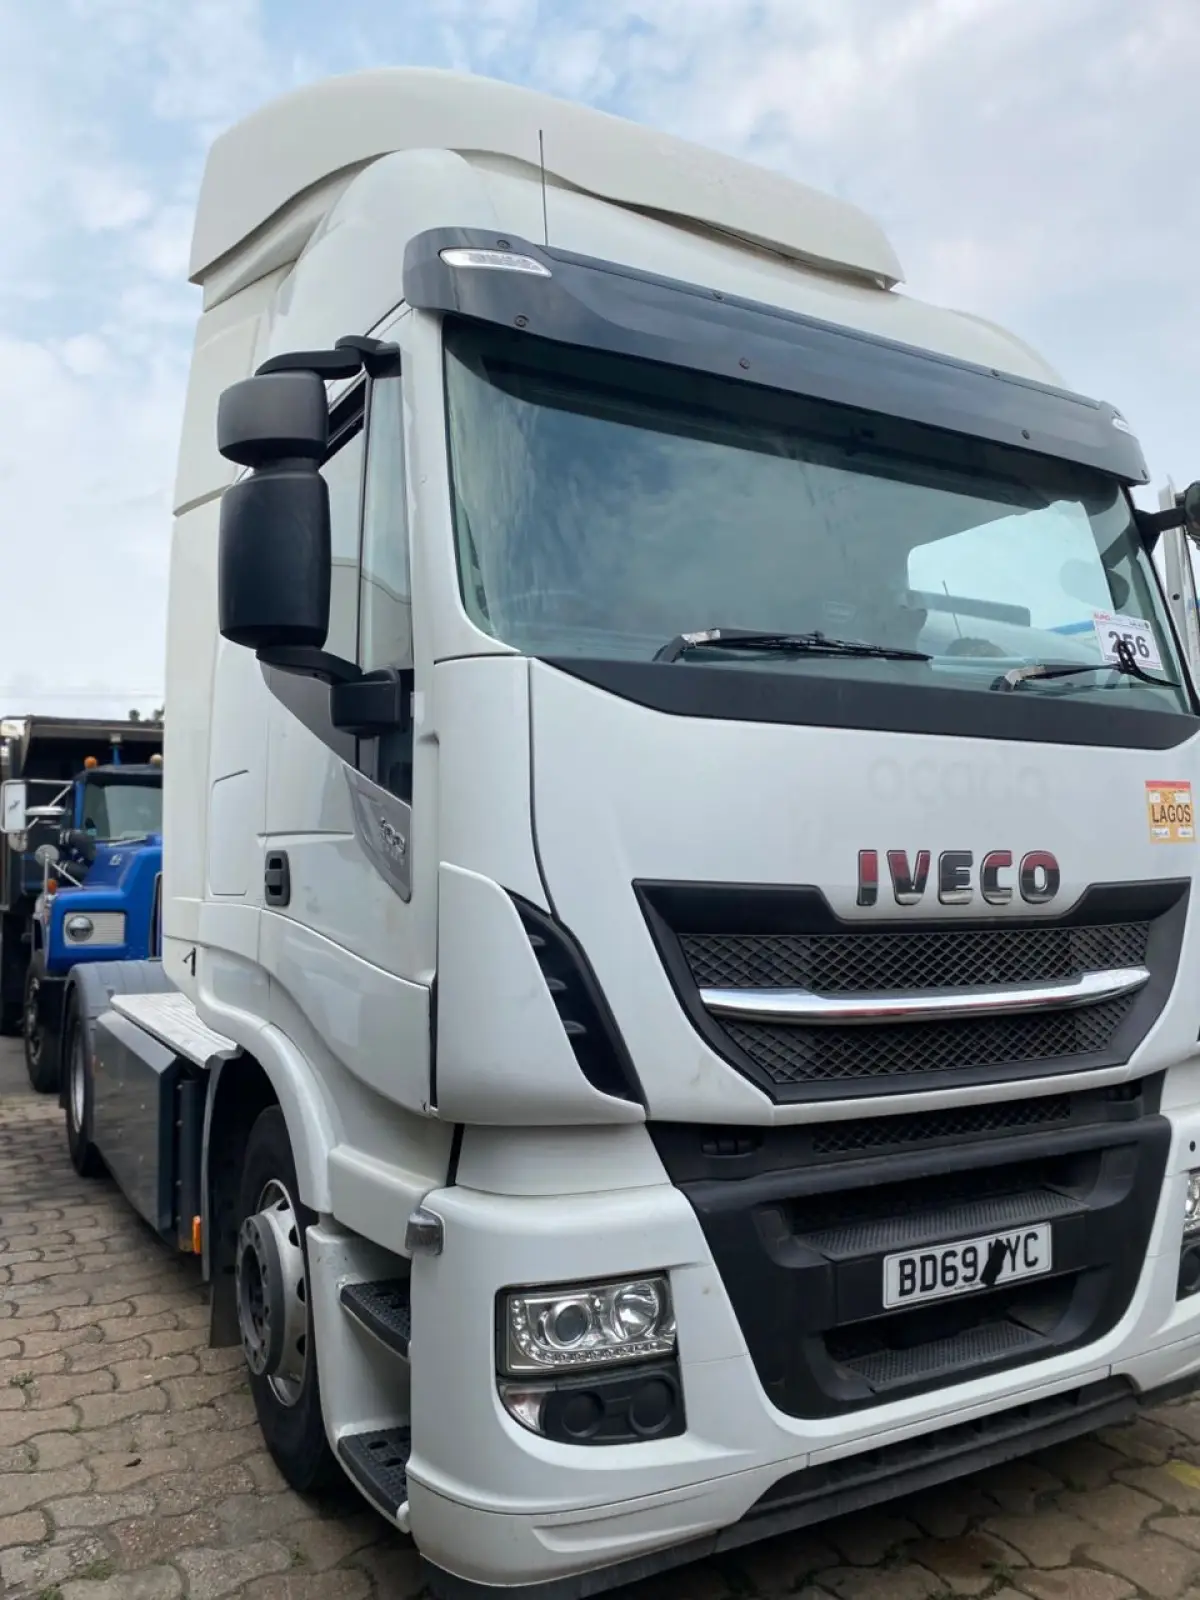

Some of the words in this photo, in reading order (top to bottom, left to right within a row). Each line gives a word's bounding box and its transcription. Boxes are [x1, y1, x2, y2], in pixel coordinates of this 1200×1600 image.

[1108, 630, 1150, 658] 256
[1151, 804, 1191, 823] LAGOS
[856, 849, 1060, 906] IVECO
[898, 1245, 979, 1297] BD69
[983, 1231, 1039, 1281] YC
